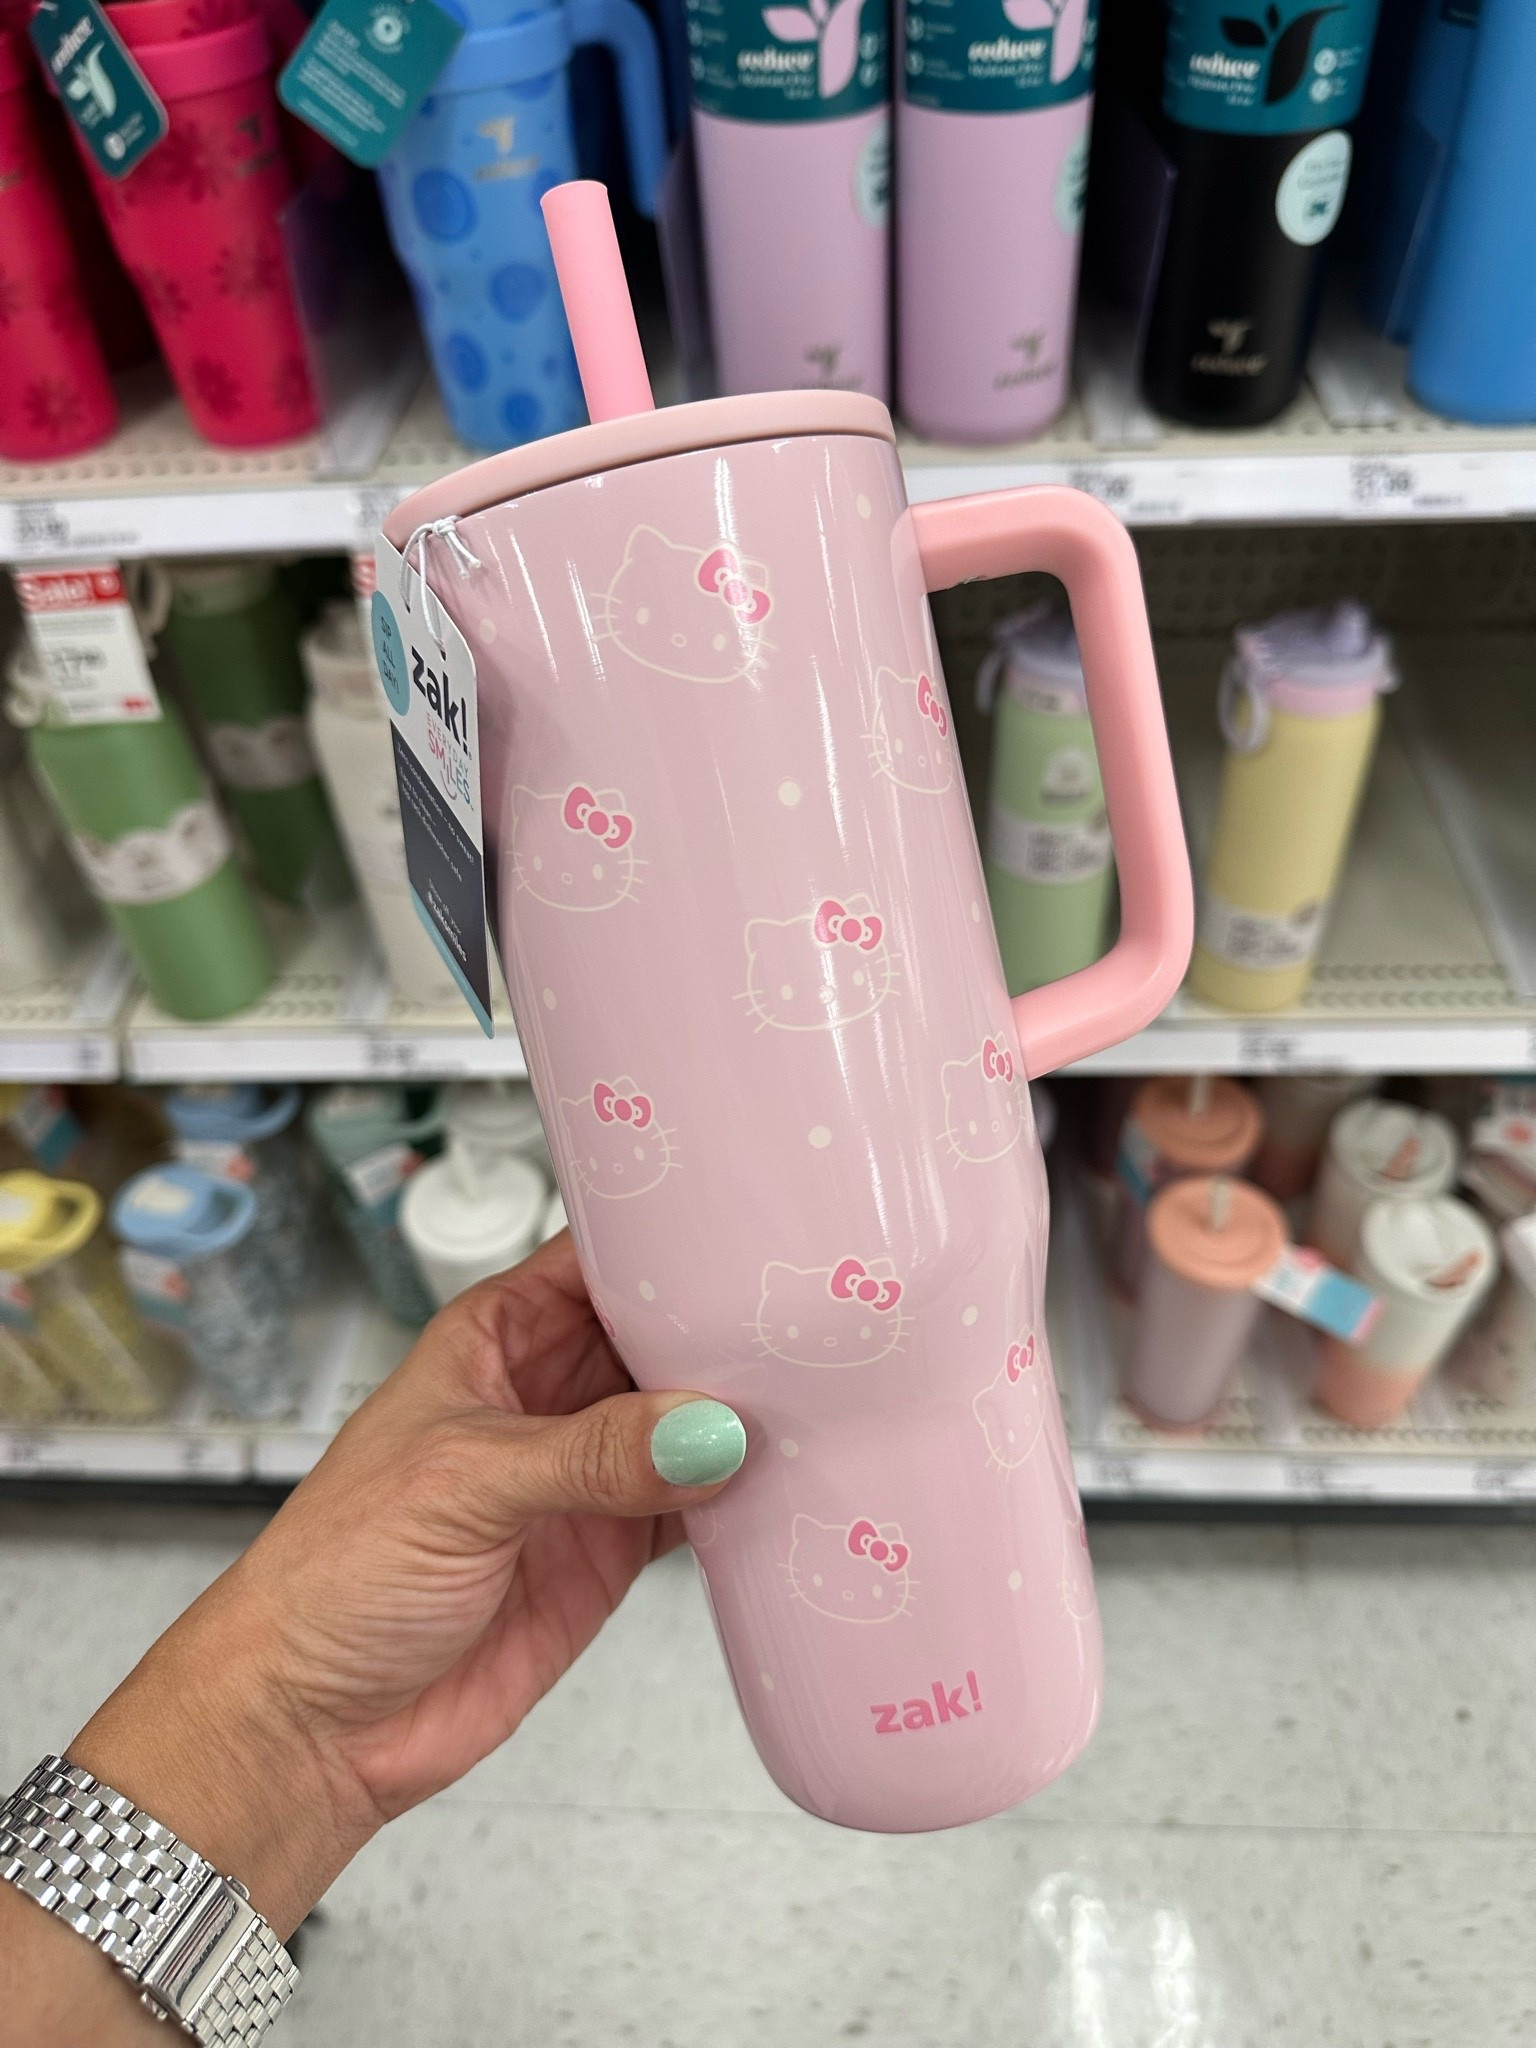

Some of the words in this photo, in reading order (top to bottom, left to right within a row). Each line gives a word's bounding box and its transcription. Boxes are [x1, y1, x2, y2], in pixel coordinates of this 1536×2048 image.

[381, 616, 391, 639] SIP
[382, 641, 396, 669] ALL
[411, 644, 468, 756] zak!
[397, 740, 410, 766] Zero
[427, 711, 469, 778] EVERYDAY
[428, 728, 471, 806] SMILES
[870, 1669, 982, 1734] zak!
